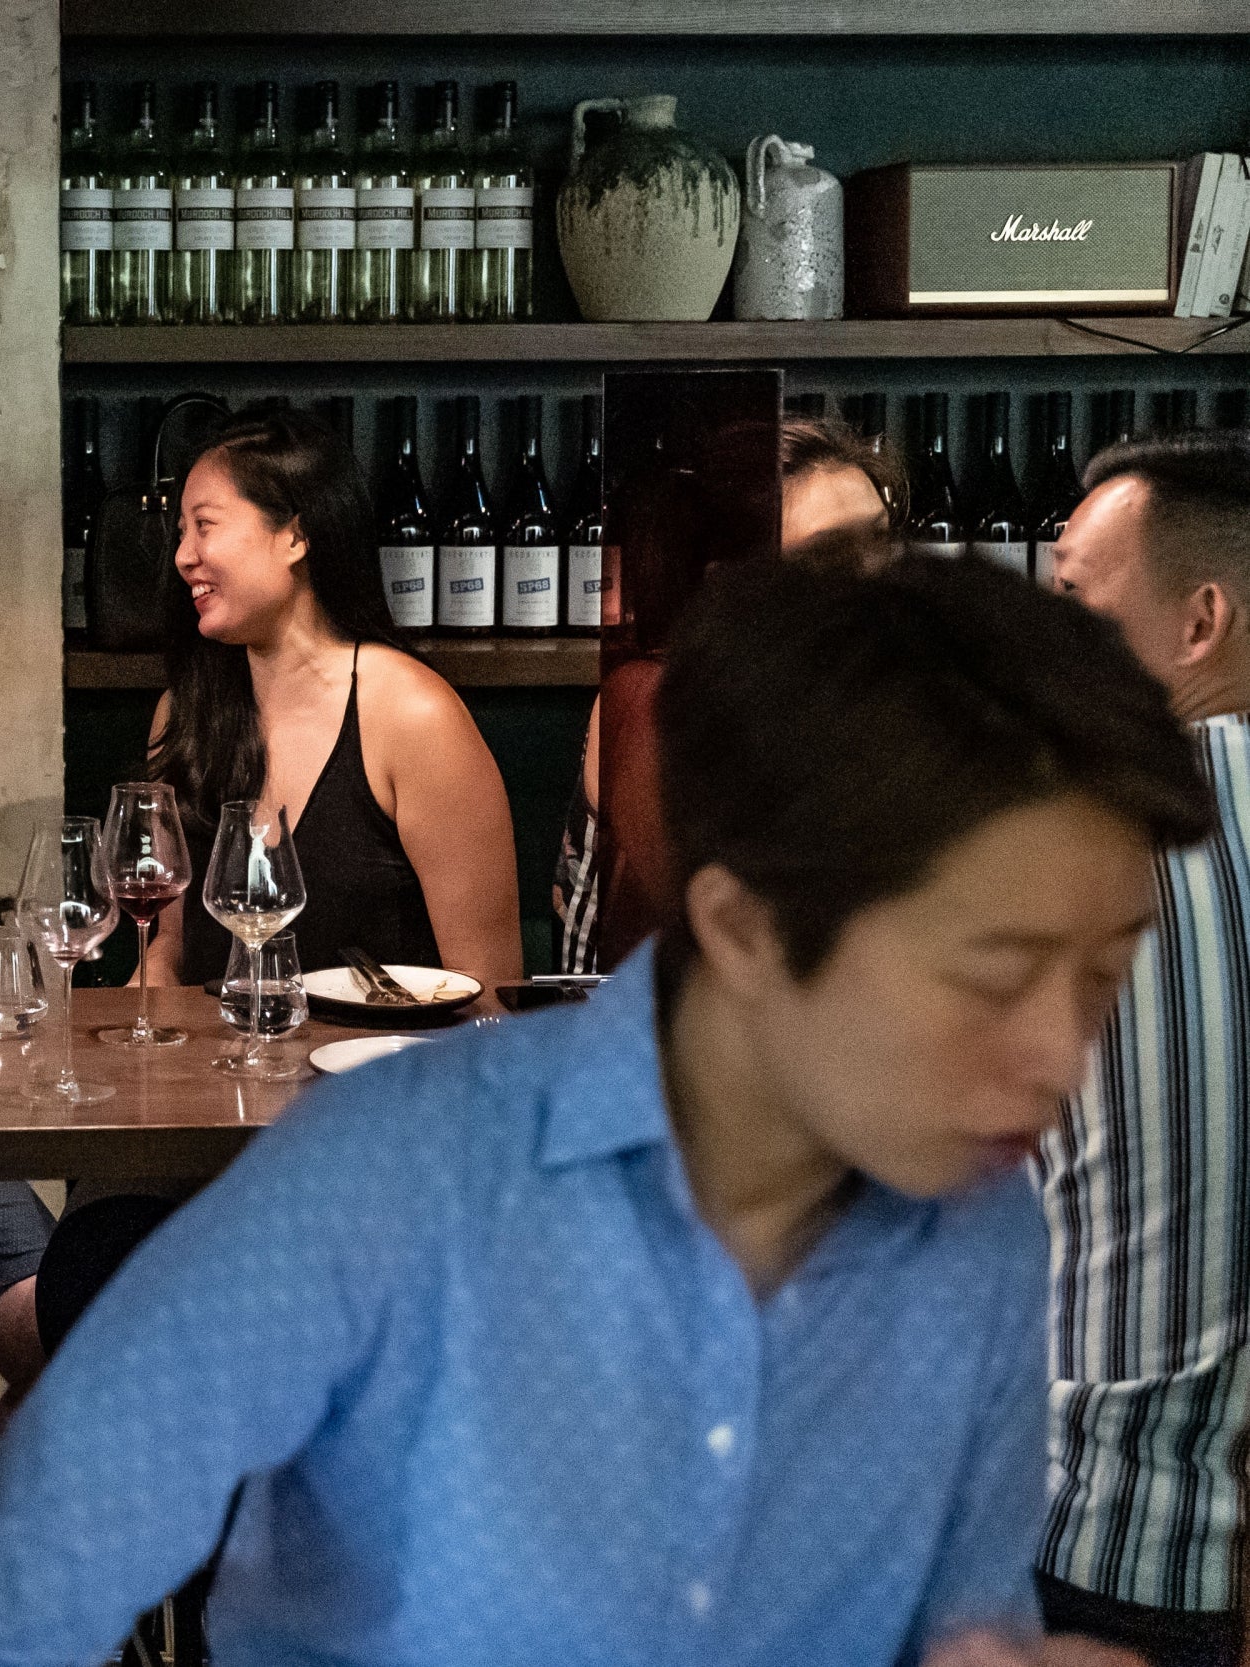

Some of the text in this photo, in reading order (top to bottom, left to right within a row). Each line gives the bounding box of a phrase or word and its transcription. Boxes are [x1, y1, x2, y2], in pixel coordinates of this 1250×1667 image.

[990, 214, 1093, 242] Marshall
[394, 579, 424, 593] SP68
[452, 579, 482, 593] SP68
[519, 579, 549, 593] SP68
